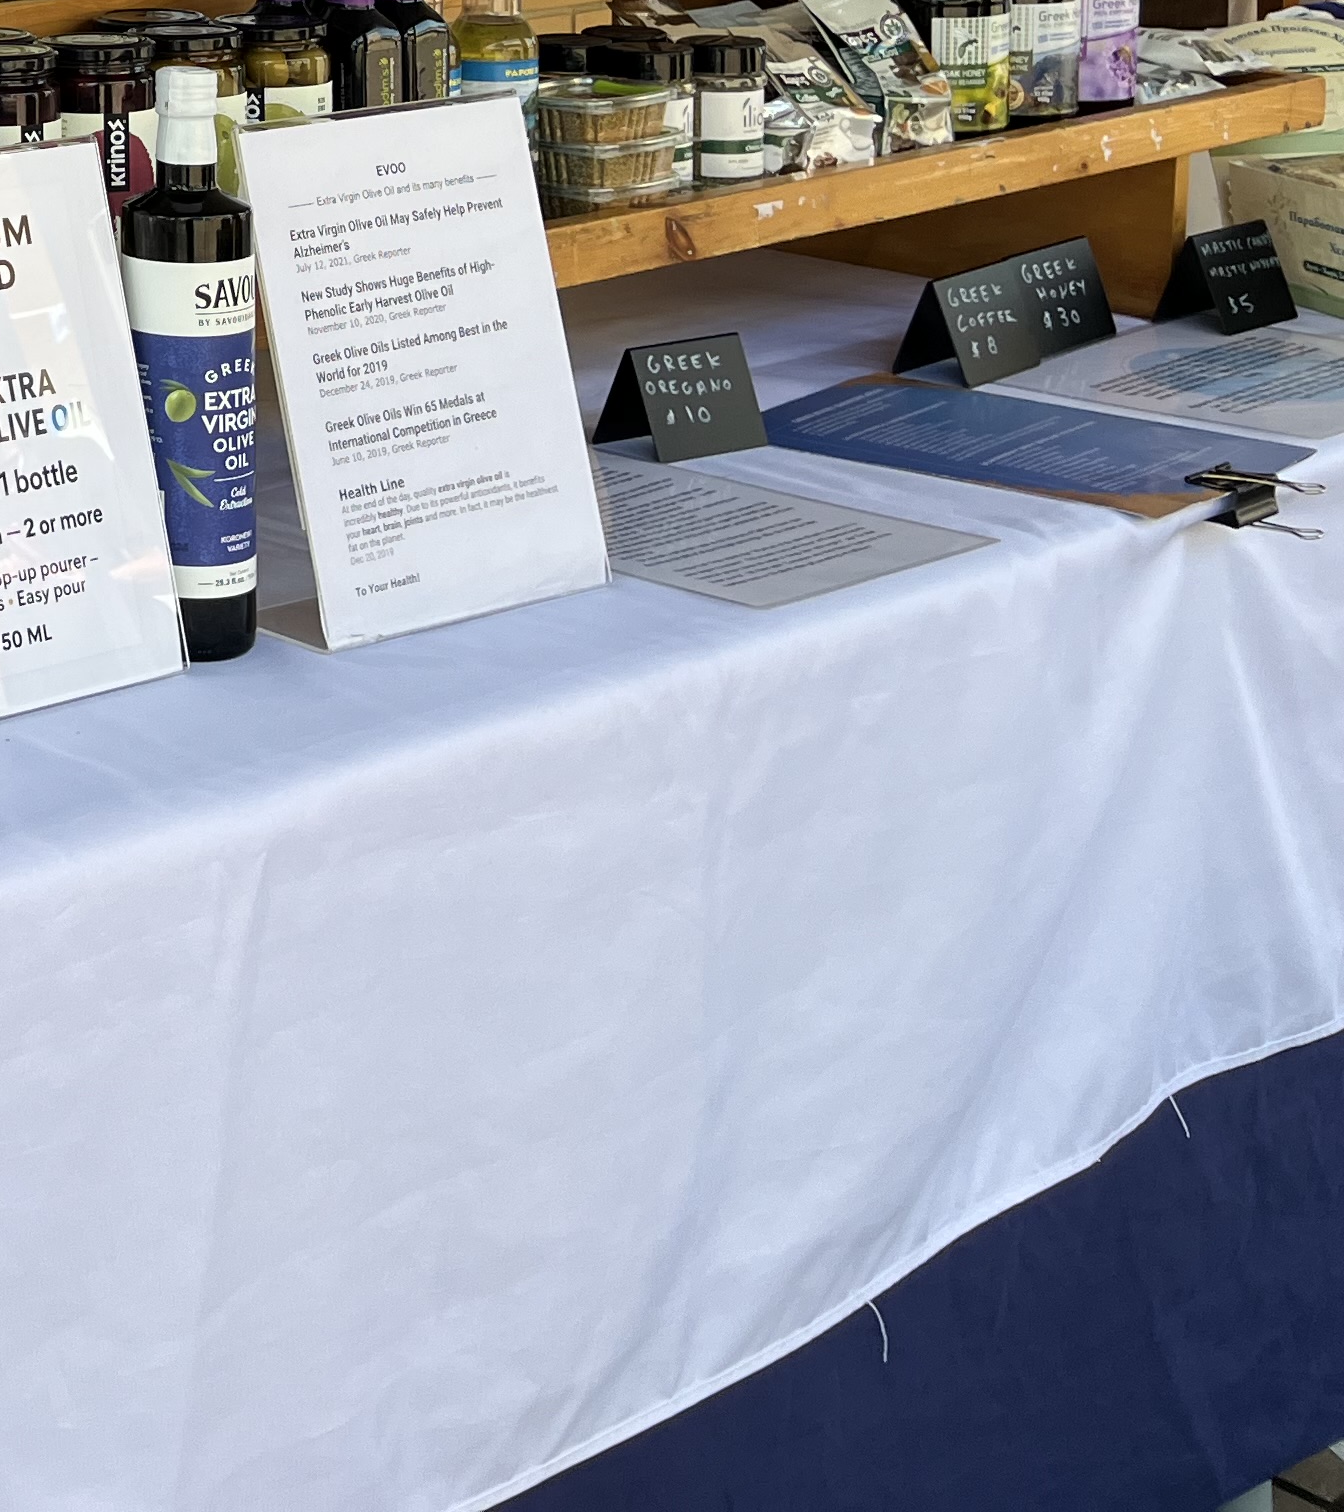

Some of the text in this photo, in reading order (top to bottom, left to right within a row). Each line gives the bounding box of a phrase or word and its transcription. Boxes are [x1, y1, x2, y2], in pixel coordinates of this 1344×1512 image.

[376, 162, 406, 176] EVOO
[290, 198, 503, 242] Extra Virgin Olive Oil May Safely Help Prevent
[293, 240, 350, 259] Alzheimer's
[1200, 238, 1244, 257] MASTIC
[1021, 258, 1078, 284] GREEK
[947, 282, 1003, 308] GREEK
[1035, 279, 1086, 302] HONEY
[957, 309, 1018, 333] COFFEE
[1043, 307, 1080, 331] $30
[971, 335, 998, 359] $8
[647, 351, 721, 374] GREEK
[645, 378, 732, 396] OREGANO
[52, 401, 91, 432] OIL
[325, 392, 485, 433] Greek Olive Oils Win 65 Medals at
[225, 452, 249, 471] OIL
[14, 460, 79, 494] bottle
[339, 477, 405, 501] Health Line
[23, 518, 36, 538] 2
[40, 518, 56, 535] or
[60, 508, 103, 531] more
[40, 555, 87, 579] pourer
[17, 588, 50, 607] Easy
[54, 580, 87, 602] pour
[356, 573, 420, 597] To Your Health!
[27, 624, 53, 645] ML
